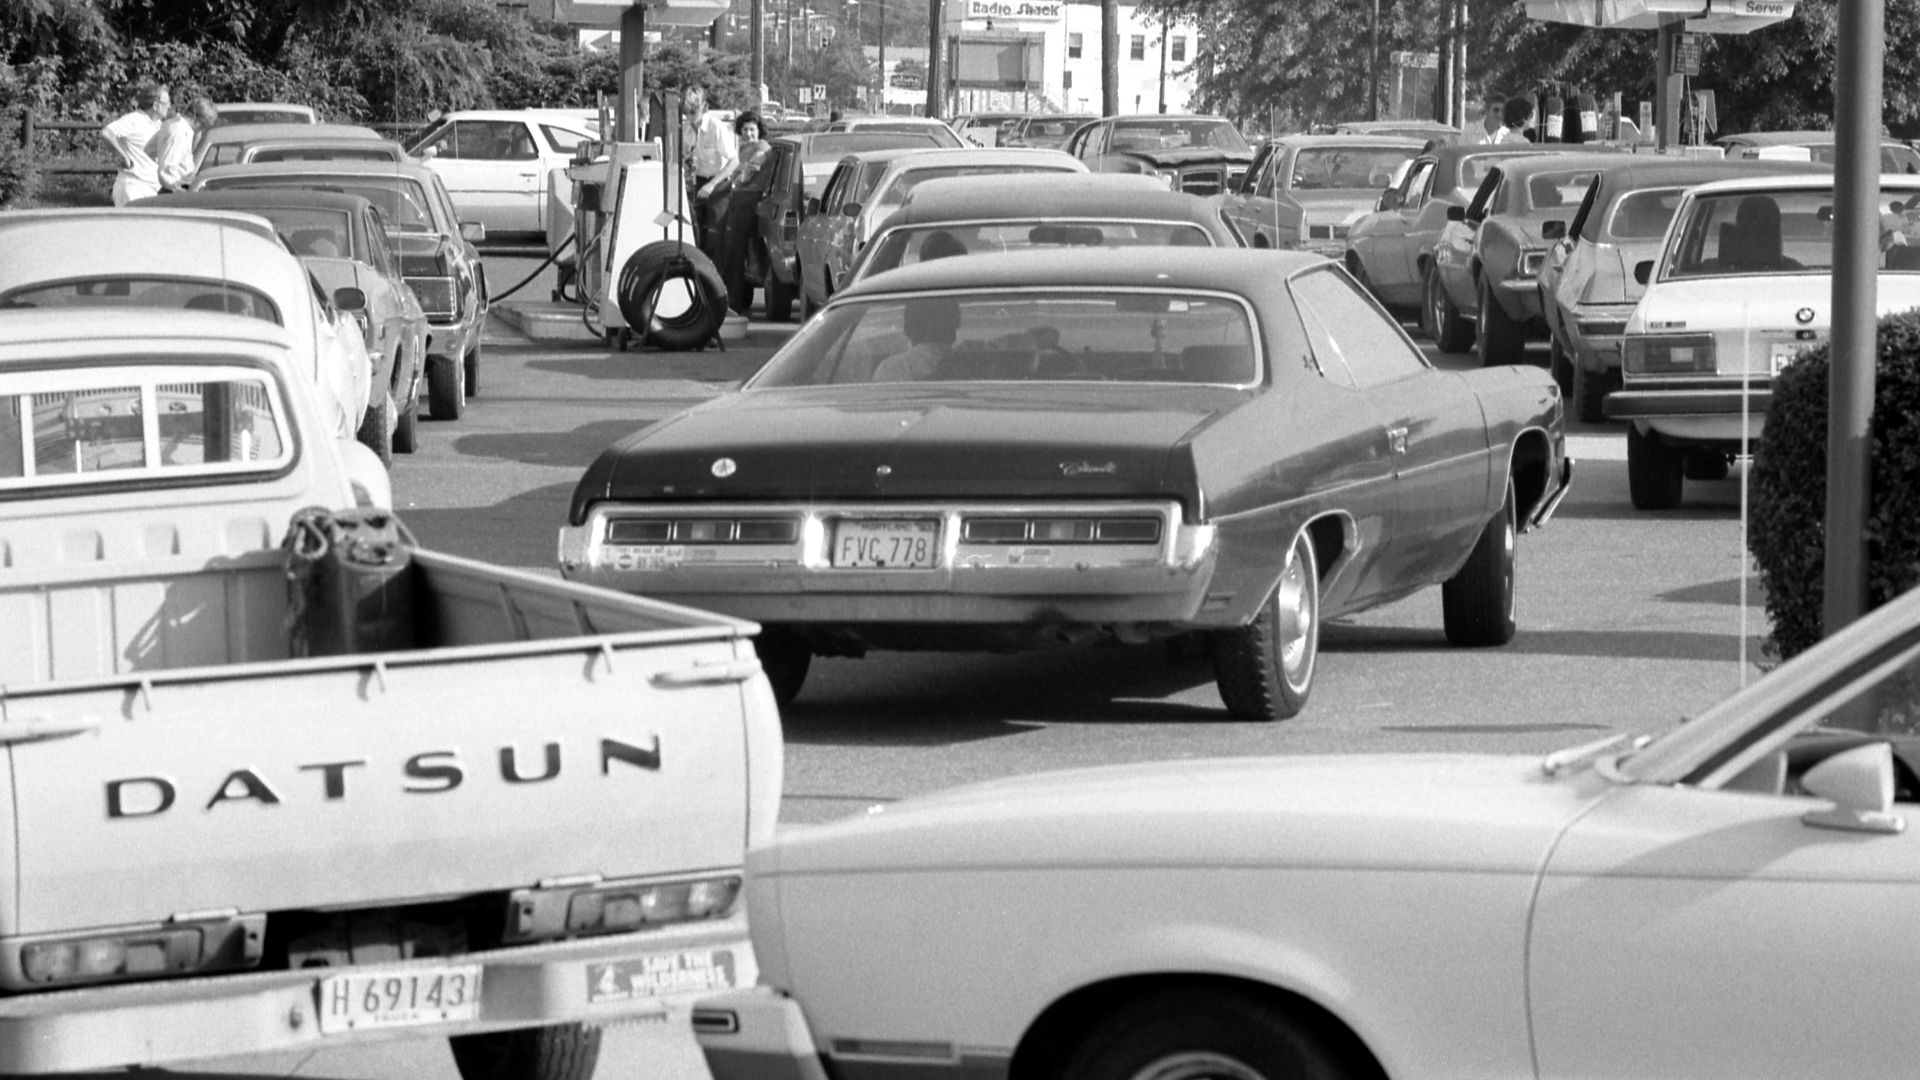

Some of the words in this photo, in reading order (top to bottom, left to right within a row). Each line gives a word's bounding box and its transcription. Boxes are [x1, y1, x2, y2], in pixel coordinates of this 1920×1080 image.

[973, 1, 1012, 16] Radio
[1016, 3, 1060, 16] Shack
[1746, 0, 1783, 13] Serve
[842, 536, 881, 562] FVC
[890, 536, 927, 562] 778
[106, 735, 661, 818] DATSUN
[332, 978, 350, 1015] H
[363, 973, 466, 1013] 69143
